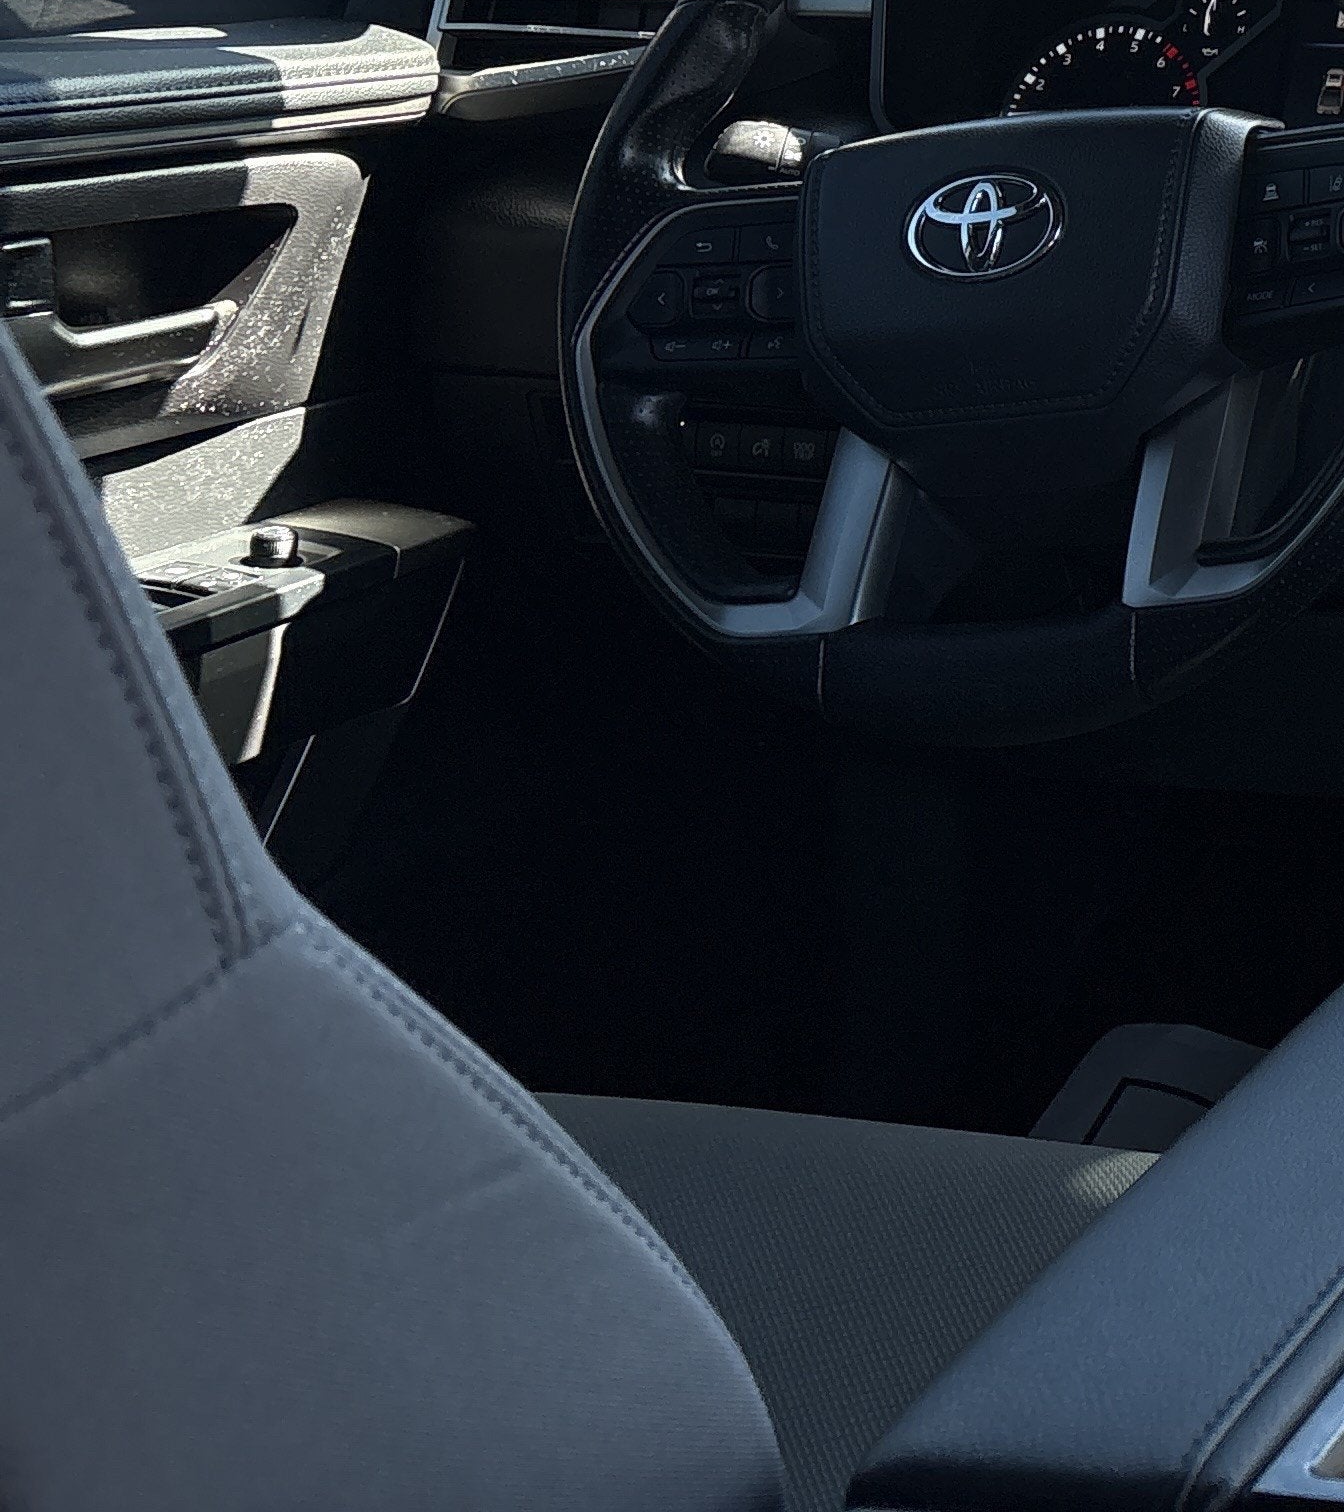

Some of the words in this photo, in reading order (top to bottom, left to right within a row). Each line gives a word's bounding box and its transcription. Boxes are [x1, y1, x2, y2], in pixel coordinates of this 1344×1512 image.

[1095, 40, 1105, 53] 4
[1130, 41, 1140, 54] 5
[1062, 53, 1072, 67] 3
[1156, 57, 1166, 69] 6
[1035, 79, 1046, 92] 2
[1171, 86, 1181, 98] 7
